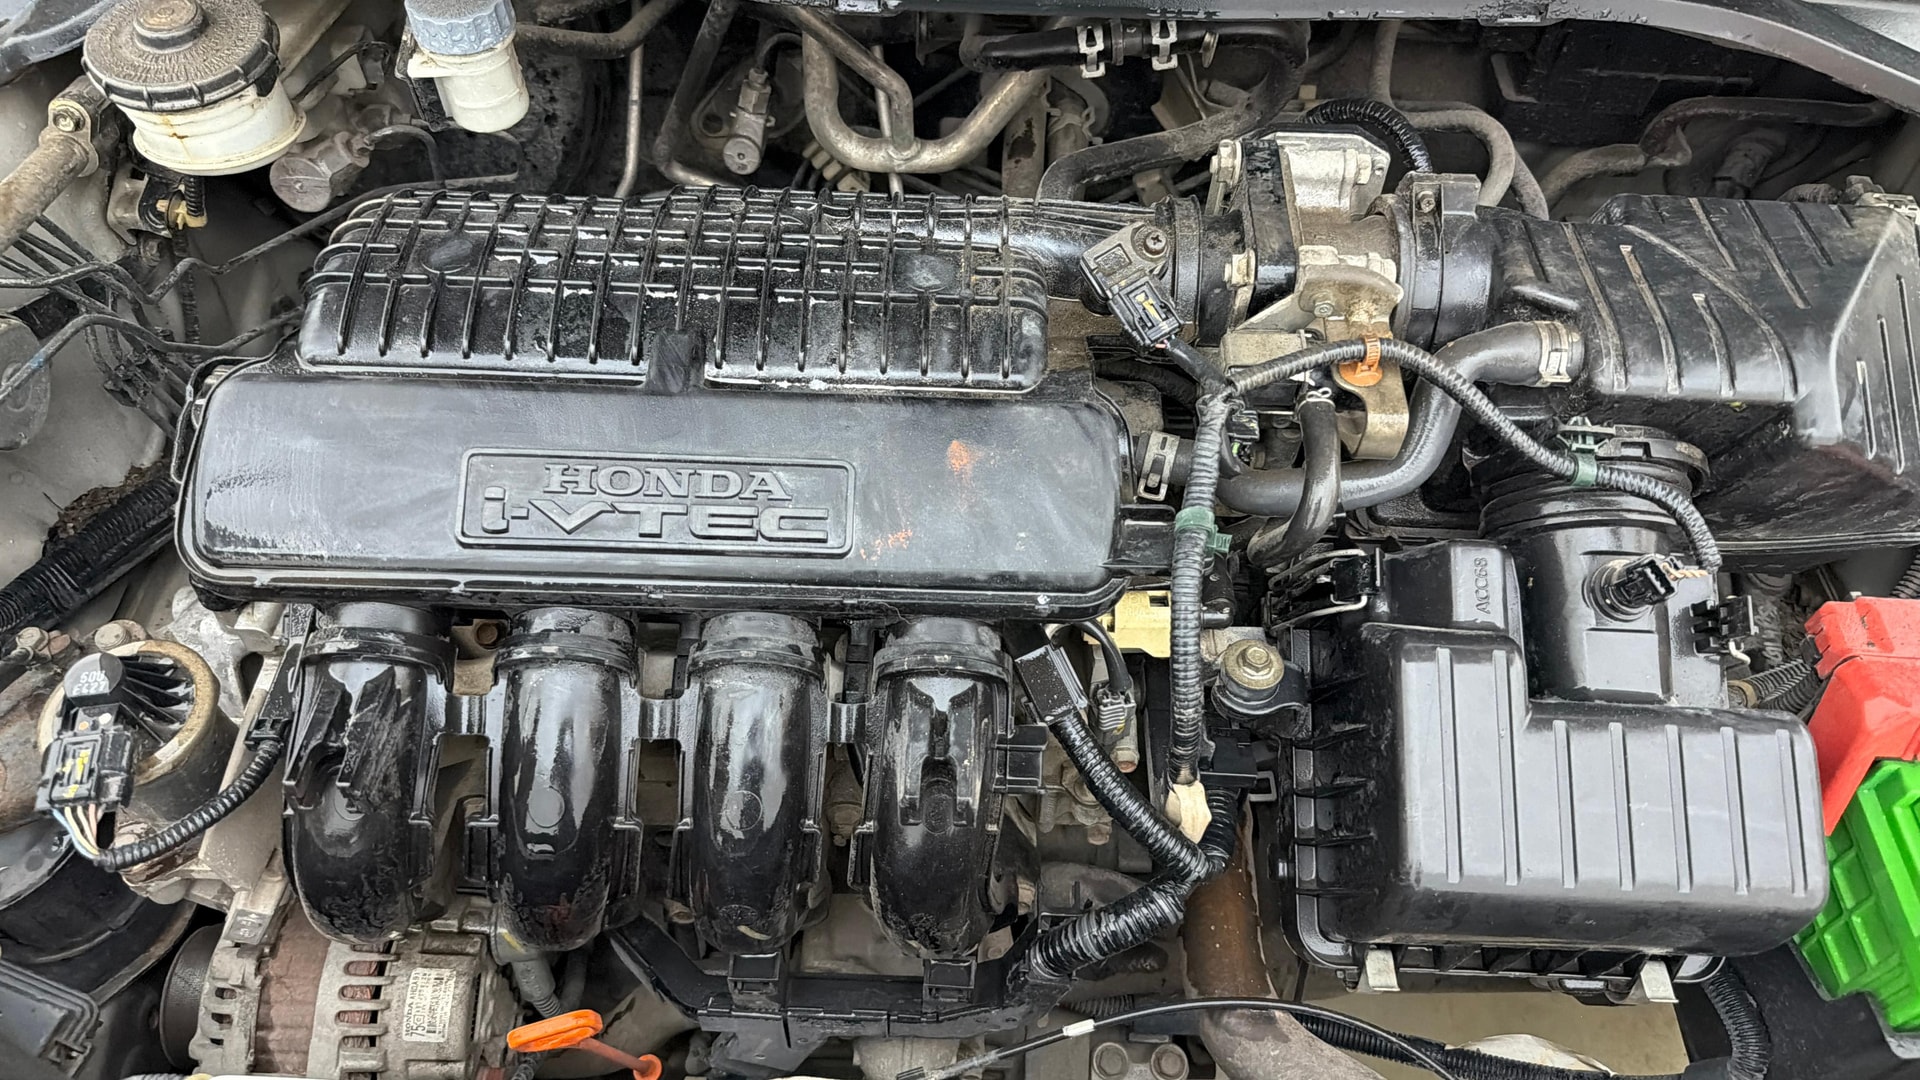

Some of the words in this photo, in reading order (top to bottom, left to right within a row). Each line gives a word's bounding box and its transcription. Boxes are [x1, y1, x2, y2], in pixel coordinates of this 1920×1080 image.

[542, 463, 793, 501] HONDA
[481, 485, 829, 543] i-VTEC
[1473, 557, 1491, 615] ACC68
